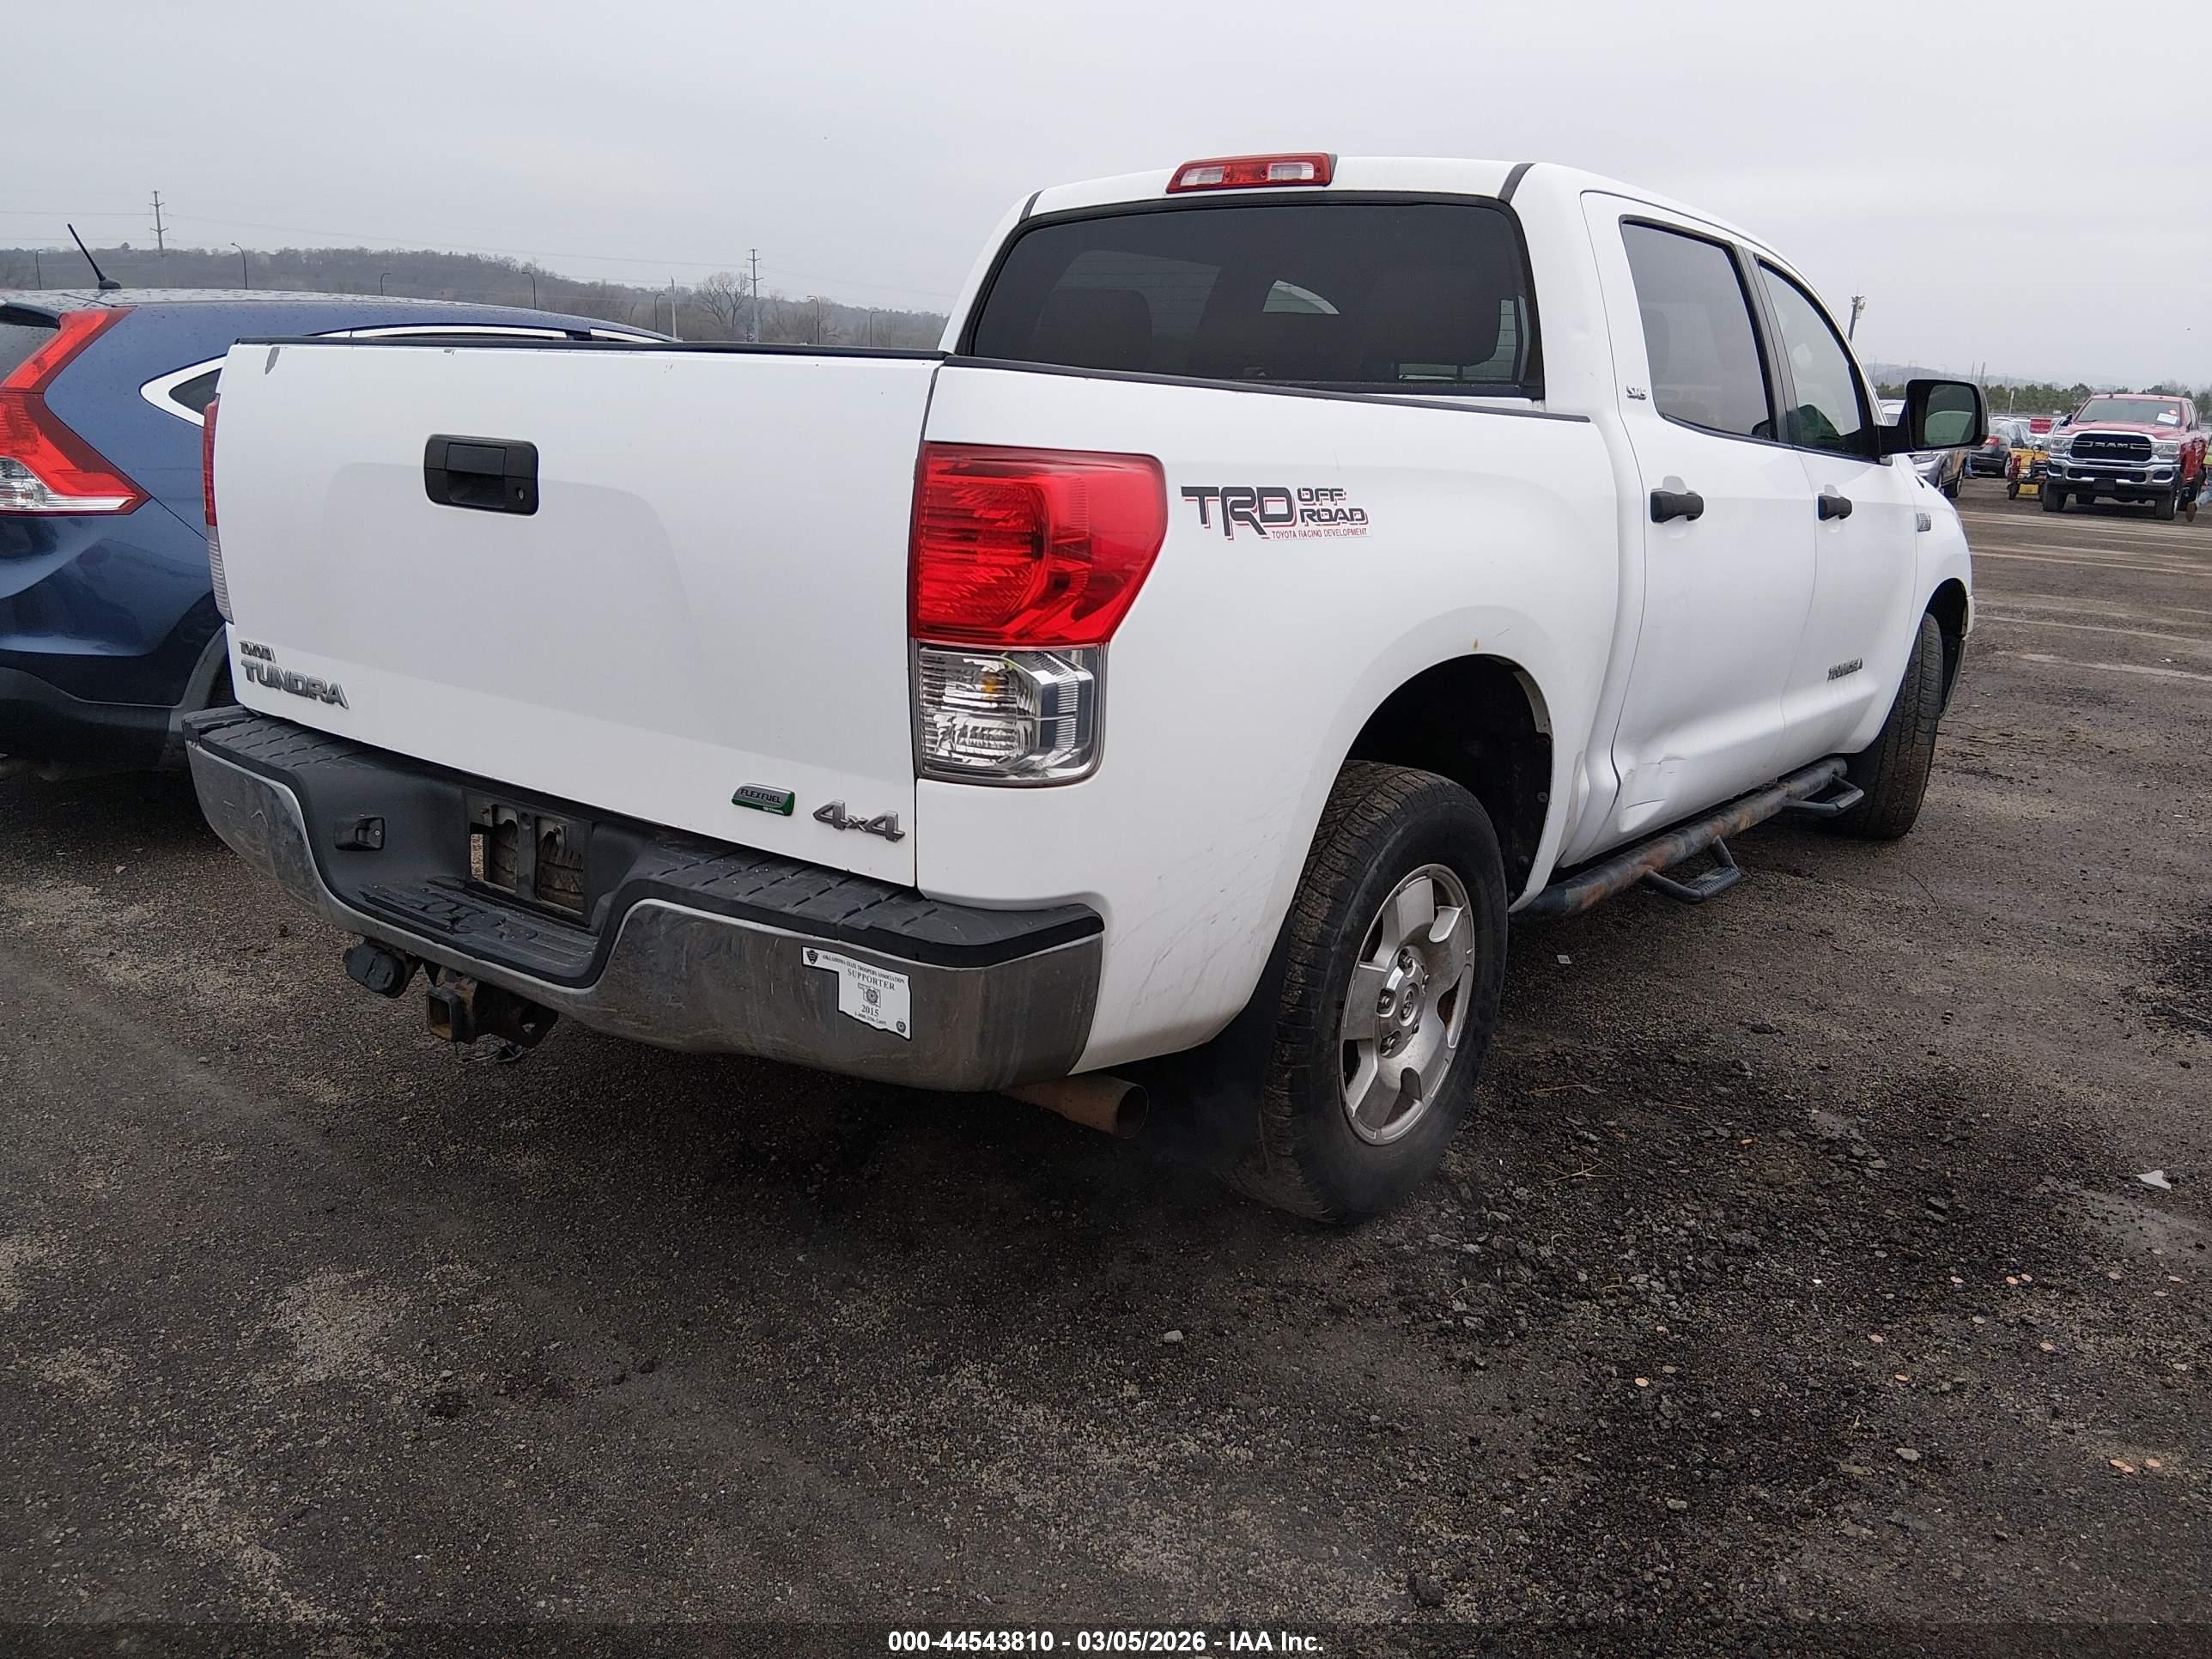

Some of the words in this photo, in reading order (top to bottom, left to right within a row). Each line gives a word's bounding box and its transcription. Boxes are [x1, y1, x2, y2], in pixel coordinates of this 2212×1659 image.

[1297, 487, 1346, 506] OFF
[1181, 486, 1297, 540] TRD
[1299, 507, 1369, 526] ROAD
[1272, 530, 1297, 539] TOYOTA
[1297, 529, 1322, 538] RACING
[1323, 528, 1367, 538] DEVELOPMENT
[240, 659, 349, 709] TUNDRA
[812, 799, 906, 843] 4x4
[847, 968, 896, 991] SUPPORTER
[861, 1004, 879, 1018] 2015
